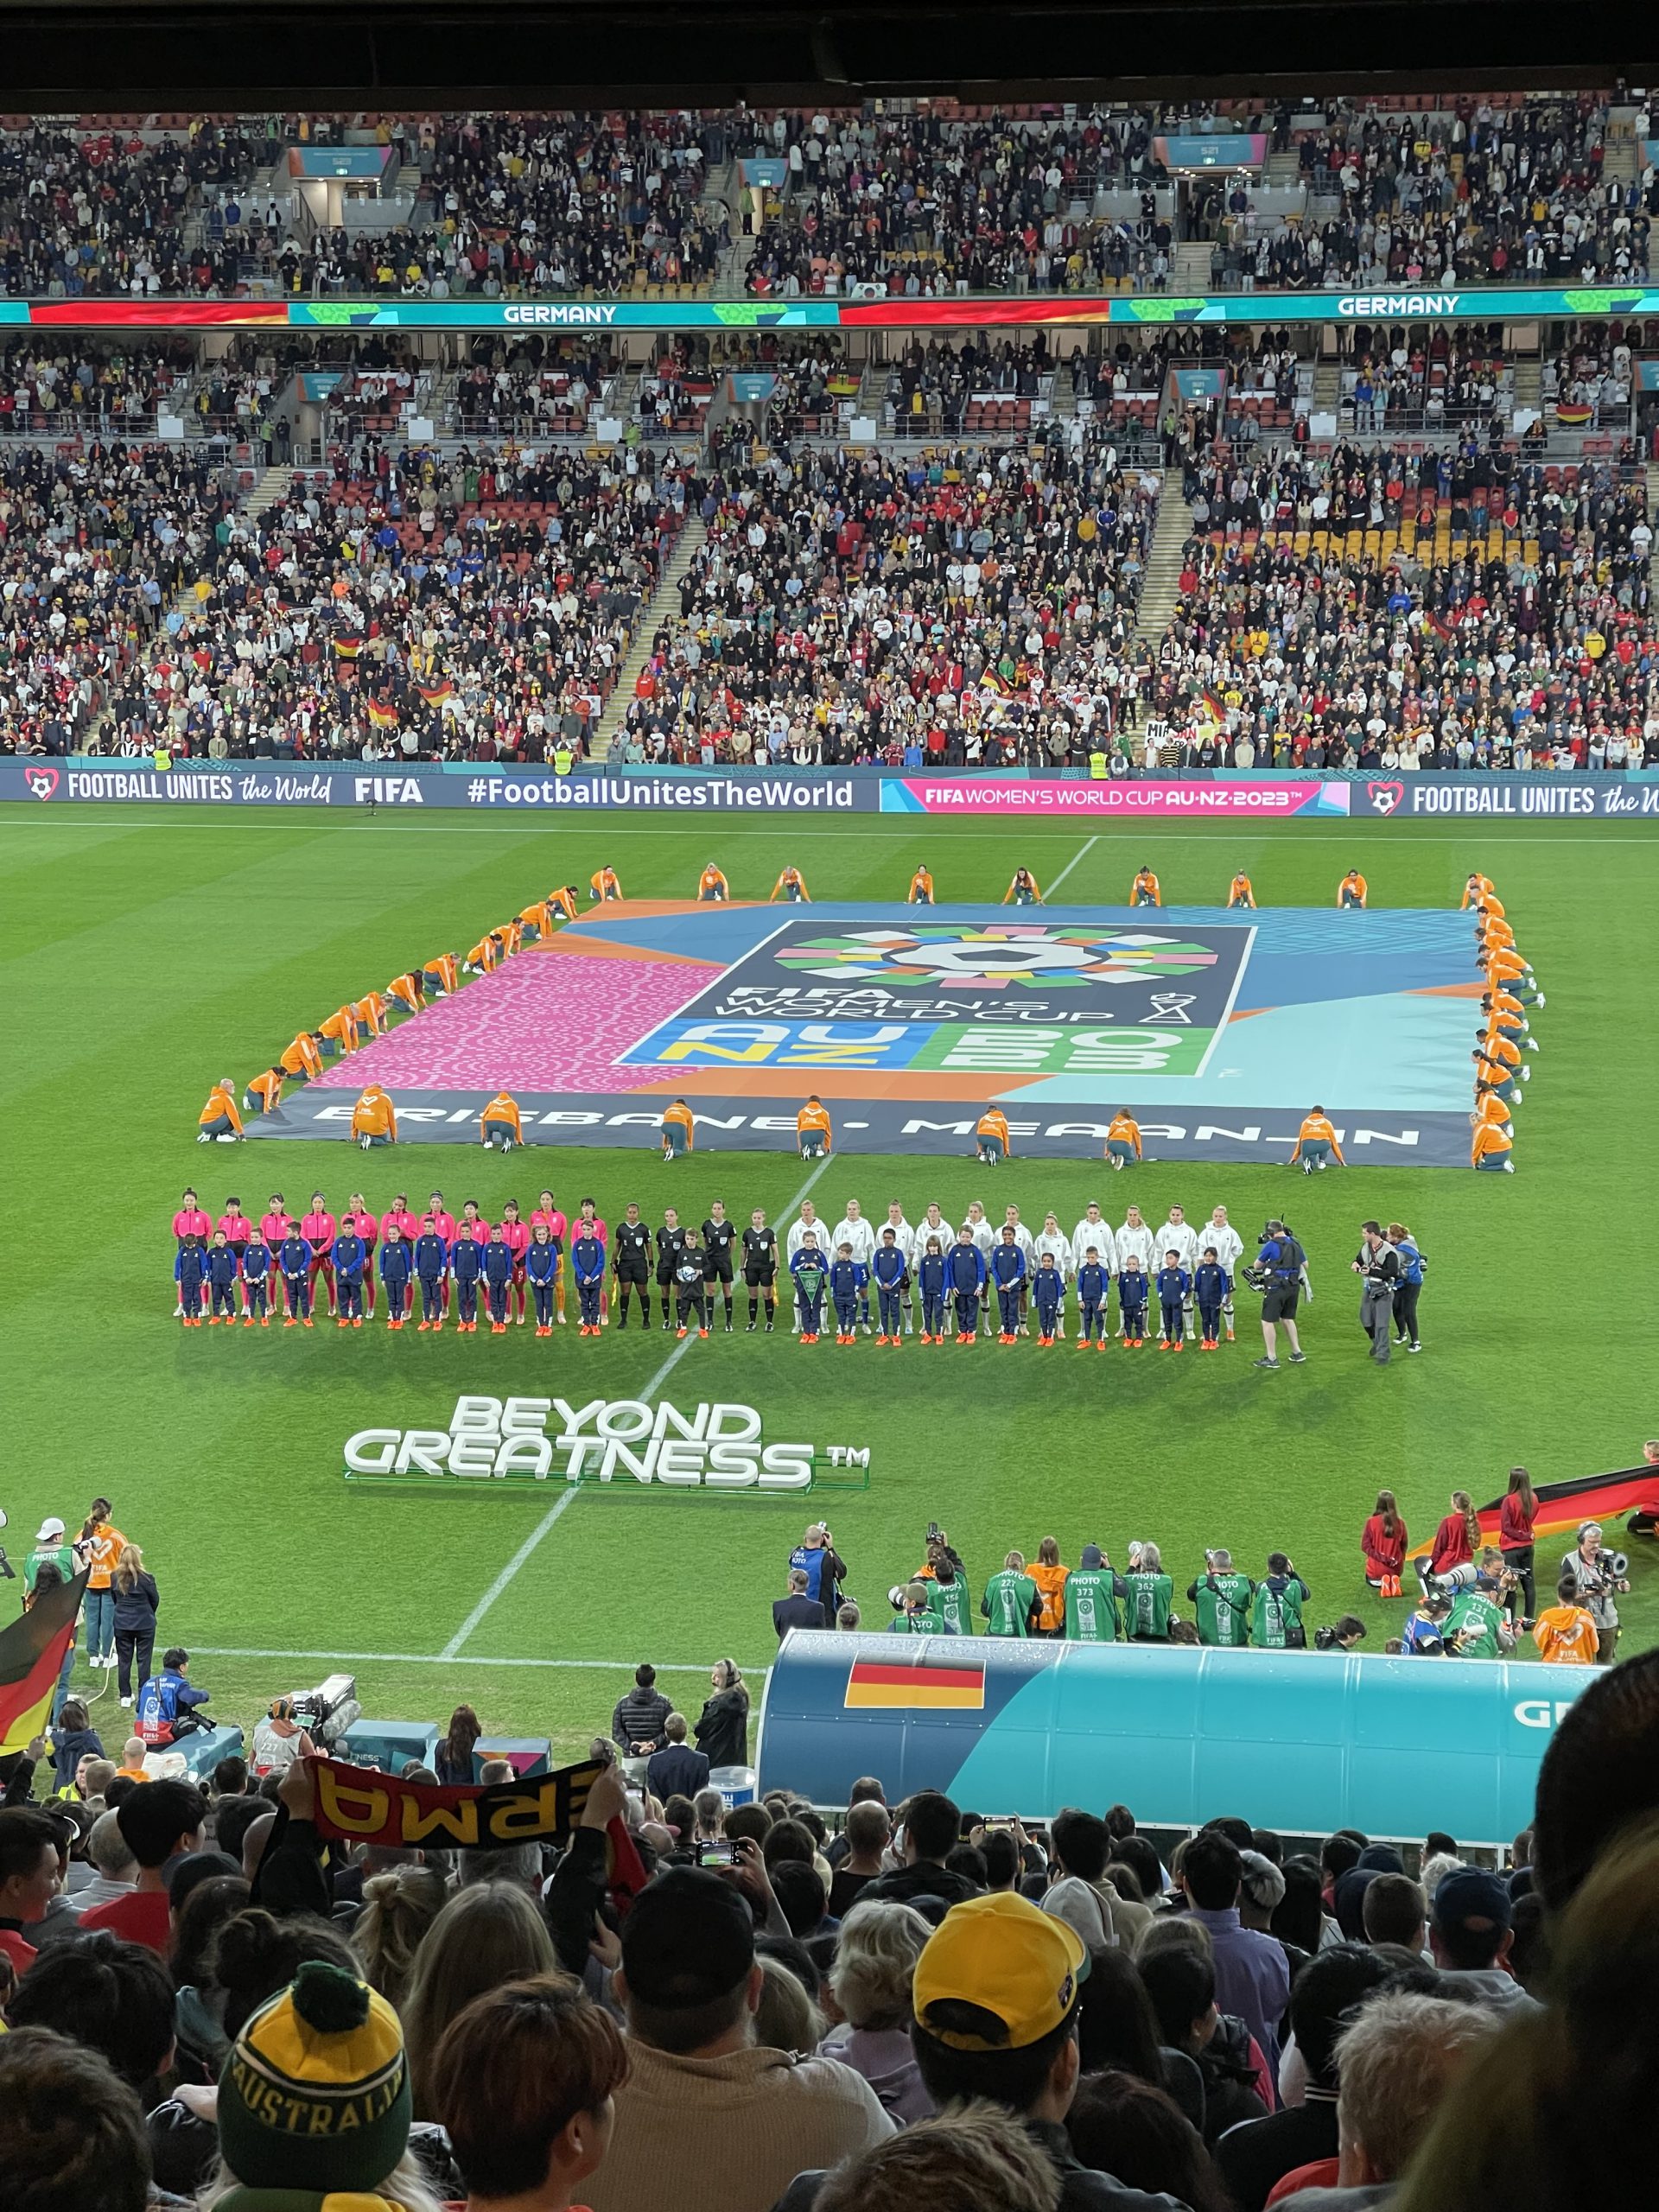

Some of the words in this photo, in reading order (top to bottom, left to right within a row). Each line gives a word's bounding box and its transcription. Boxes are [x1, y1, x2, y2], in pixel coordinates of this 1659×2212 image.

[503, 306, 616, 323] GERMANY
[1338, 296, 1460, 315] GERMANY
[67, 773, 162, 799] FOOTBALL
[167, 775, 232, 800] UNITES
[238, 774, 272, 800] the
[274, 775, 333, 804] World
[354, 778, 423, 803] FIFA
[467, 778, 854, 807] #FootballUnitesTheWorld
[925, 788, 964, 804] FIFA
[965, 788, 1053, 804] WOMEN'S
[1056, 790, 1122, 805] WORLD
[1125, 791, 1164, 806] CUP
[1414, 786, 1516, 812] FOOTBALL
[1522, 787, 1595, 813] UNITES
[1601, 785, 1638, 813] the
[728, 987, 895, 999] FIFA
[726, 996, 1049, 1011] WOMEN'S
[715, 1006, 960, 1019] WORLD
[973, 1009, 1115, 1022] CUP
[680, 1023, 909, 1046] AU
[656, 1041, 892, 1065] NZ
[448, 1395, 762, 1443] BEYOND
[32, 1552, 60, 1561] PHOTO
[1467, 1595, 1497, 1610] PHOTO
[1471, 1603, 1489, 1615] 131
[232, 2061, 403, 2134] AUSTRALIA
